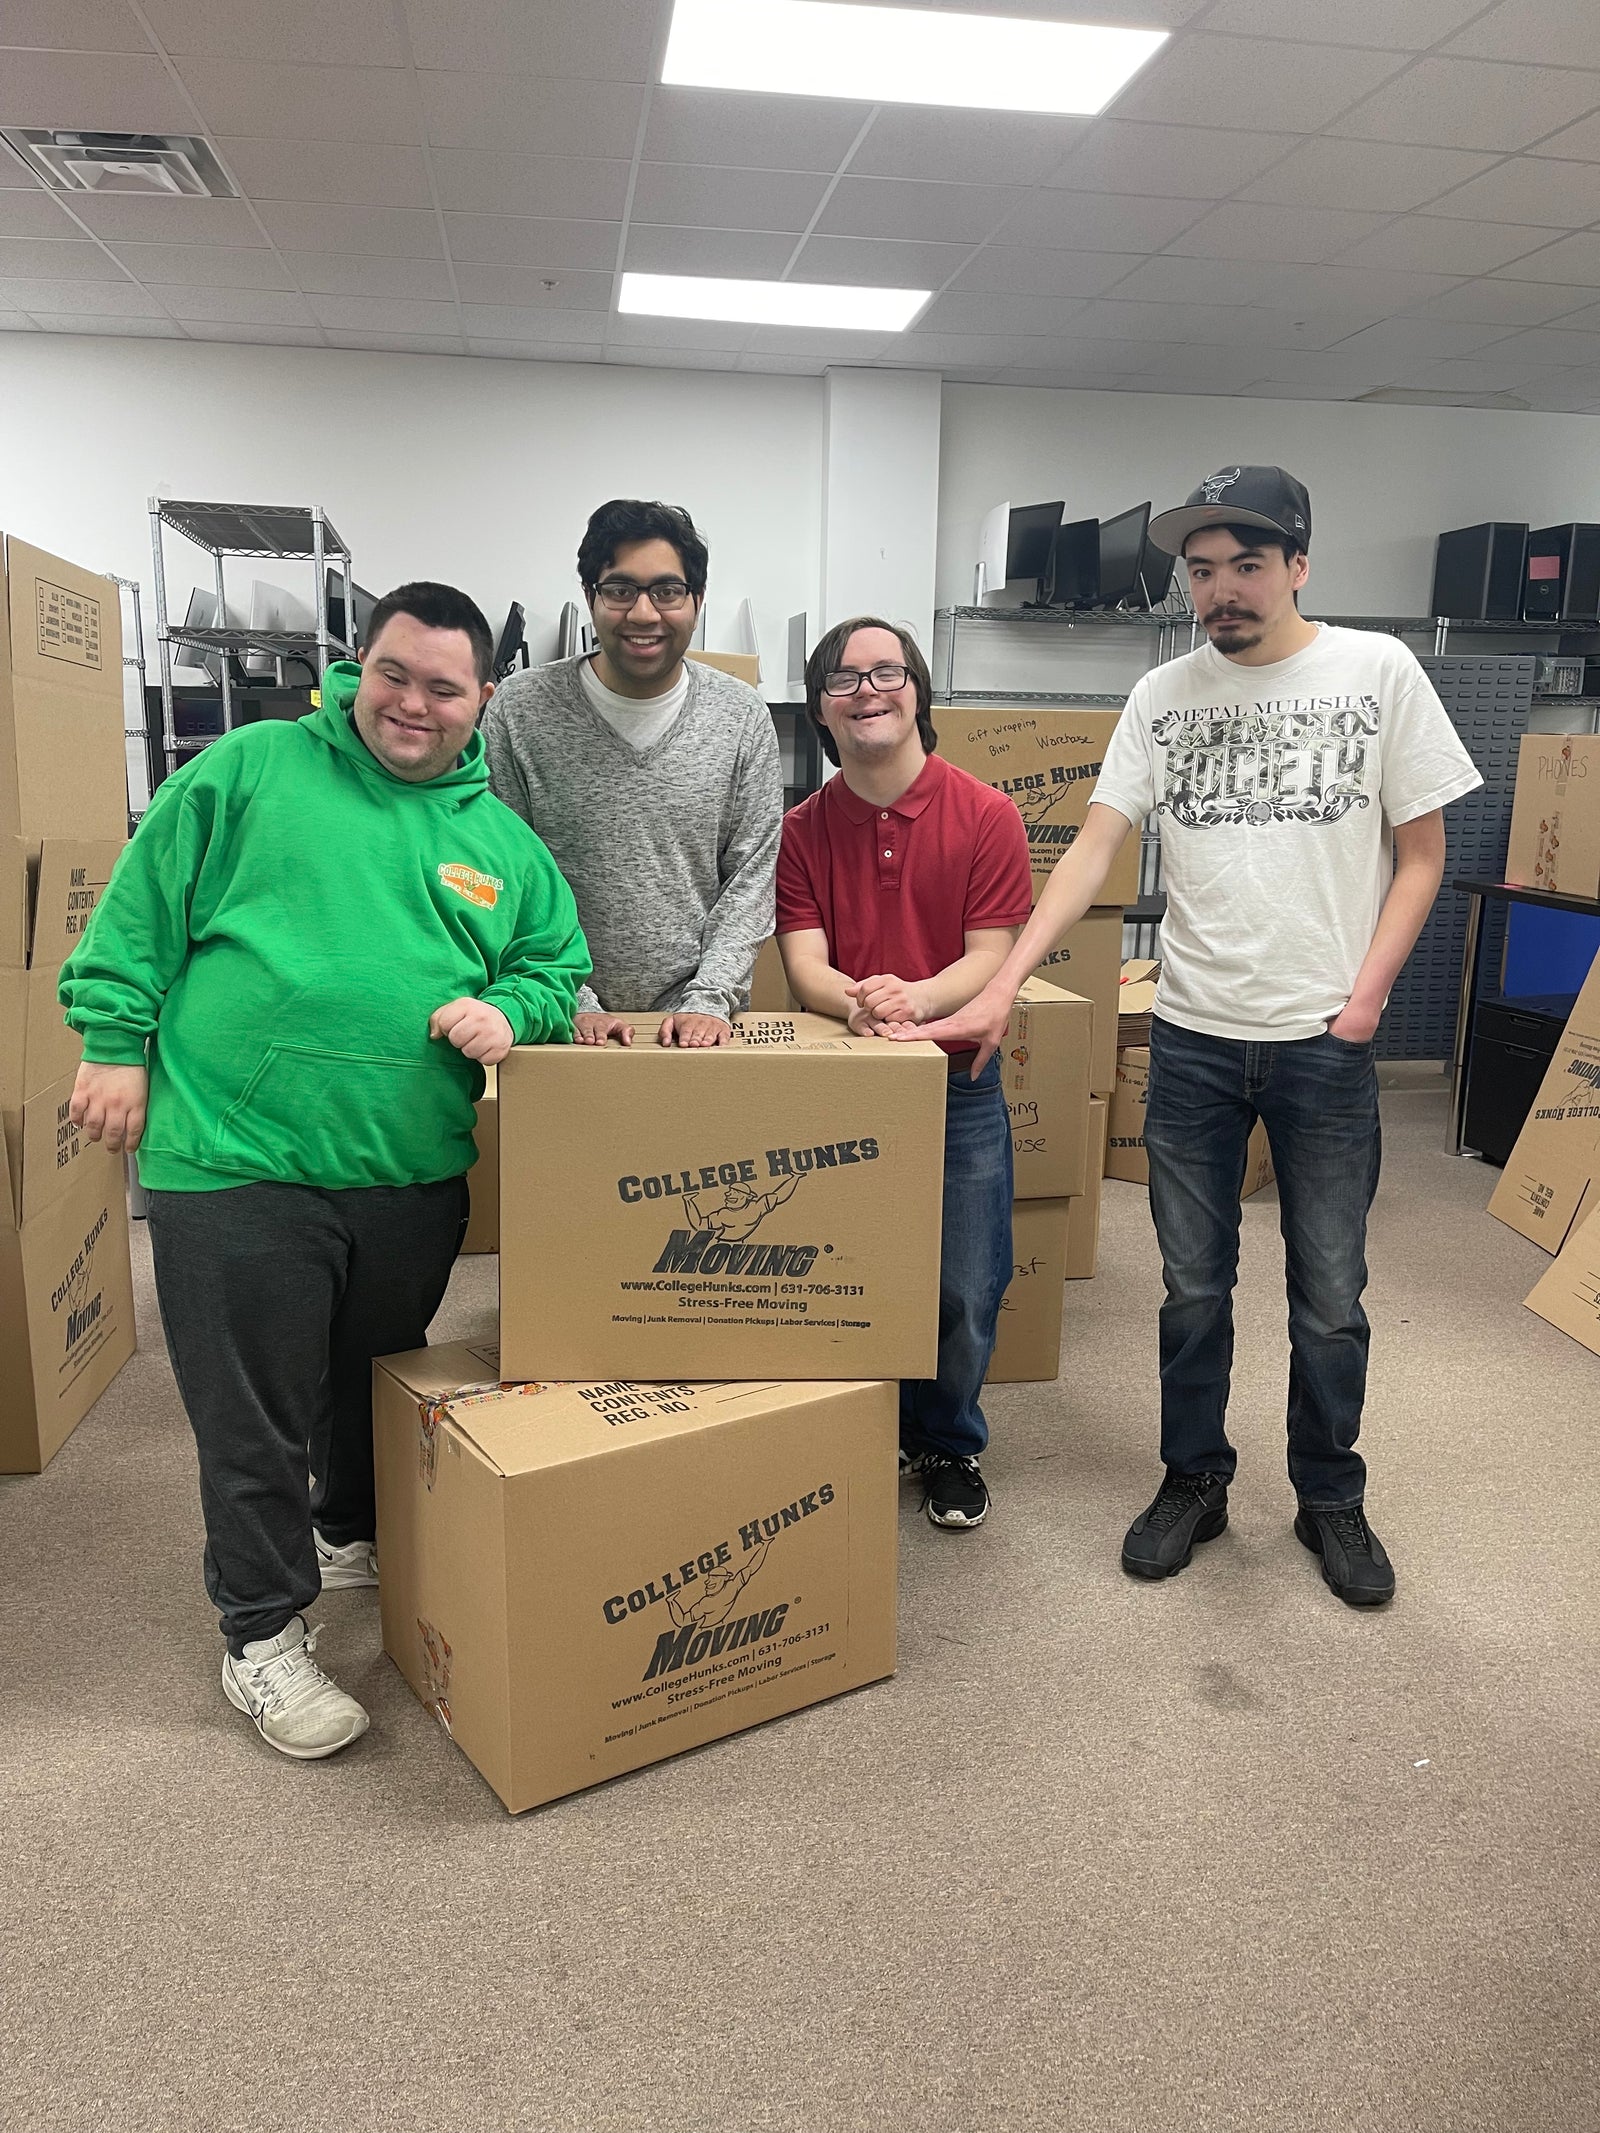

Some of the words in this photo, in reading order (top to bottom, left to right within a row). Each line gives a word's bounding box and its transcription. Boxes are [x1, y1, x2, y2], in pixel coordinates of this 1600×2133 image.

[1172, 705, 1248, 722] METAL
[1254, 695, 1368, 715] MULISHA
[967, 729, 988, 743] Gift
[988, 773, 1046, 793] LLEGE
[1050, 762, 1102, 784] HUNK
[1165, 739, 1367, 802] SOCIETY
[1538, 755, 1589, 781] PHONES
[1024, 824, 1079, 844] VING
[70, 868, 86, 887] NAME
[67, 890, 94, 911] CONTENTS
[730, 1028, 795, 1038] CONTE
[742, 1036, 795, 1045] NAME
[1109, 1136, 1146, 1147] UNKS
[618, 1159, 757, 1203] COLLEGE
[766, 1137, 879, 1177] HUNKS
[51, 1250, 85, 1312] COLLEGE
[84, 1207, 108, 1256] HUNKS
[652, 1229, 818, 1277] MOVING
[620, 1280, 771, 1294] www.CollegeHunks.com
[780, 1284, 864, 1296] 631-706-3131
[678, 1296, 754, 1309] Stress-Free
[757, 1298, 808, 1312] Moving
[65, 1292, 102, 1352] MOVING
[611, 1314, 642, 1324] Moving
[647, 1315, 666, 1323] Junk
[668, 1315, 702, 1323] Removal
[707, 1316, 744, 1325] Donation
[745, 1317, 775, 1326] Pickups
[780, 1318, 803, 1326] Labor
[804, 1318, 836, 1327] Services
[840, 1319, 871, 1328] Storage
[577, 1381, 640, 1401] NAME
[590, 1385, 696, 1413] CONTENTS
[603, 1542, 732, 1625] COLLEGE
[738, 1483, 835, 1551] HUNKS
[641, 1603, 789, 1682] MOVING
[611, 1653, 750, 1710] www.CollegeHunks.com
[758, 1623, 829, 1656] 631-706-3131
[667, 1675, 735, 1705] Stress-Free
[738, 1656, 782, 1678] Moving
[604, 1727, 634, 1744] Moving
[638, 1719, 657, 1732] Junk
[658, 1707, 689, 1723] Removal
[694, 1694, 726, 1710] Donation
[728, 1684, 754, 1699] Pickups
[758, 1674, 779, 1687] Labor
[779, 1664, 806, 1679] Services
[810, 1652, 836, 1666] Storage
